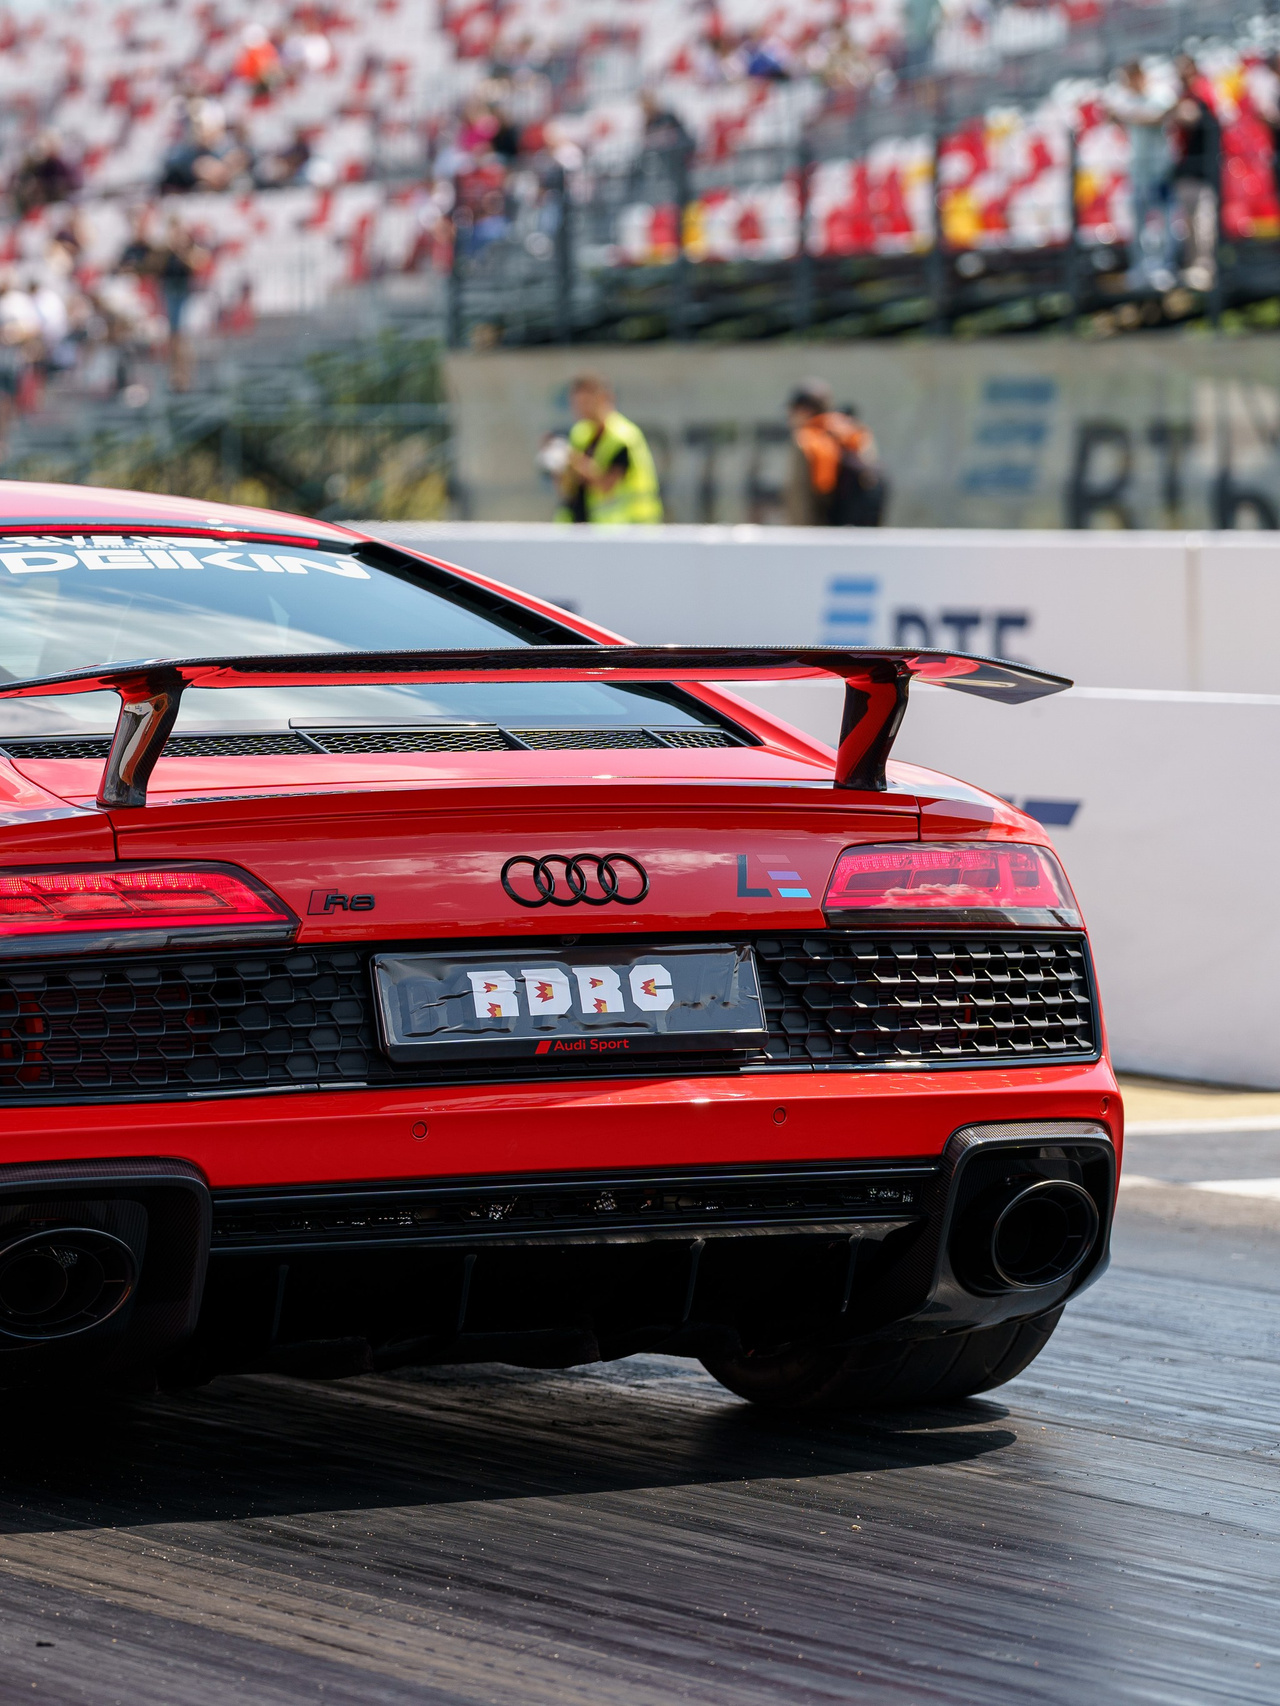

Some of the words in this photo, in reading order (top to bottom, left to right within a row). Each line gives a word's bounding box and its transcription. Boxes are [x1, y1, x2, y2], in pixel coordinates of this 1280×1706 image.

[323, 894, 376, 911] R8
[466, 964, 675, 1019] RDRC
[553, 1039, 586, 1052] Audi
[590, 1038, 630, 1053] Sport
